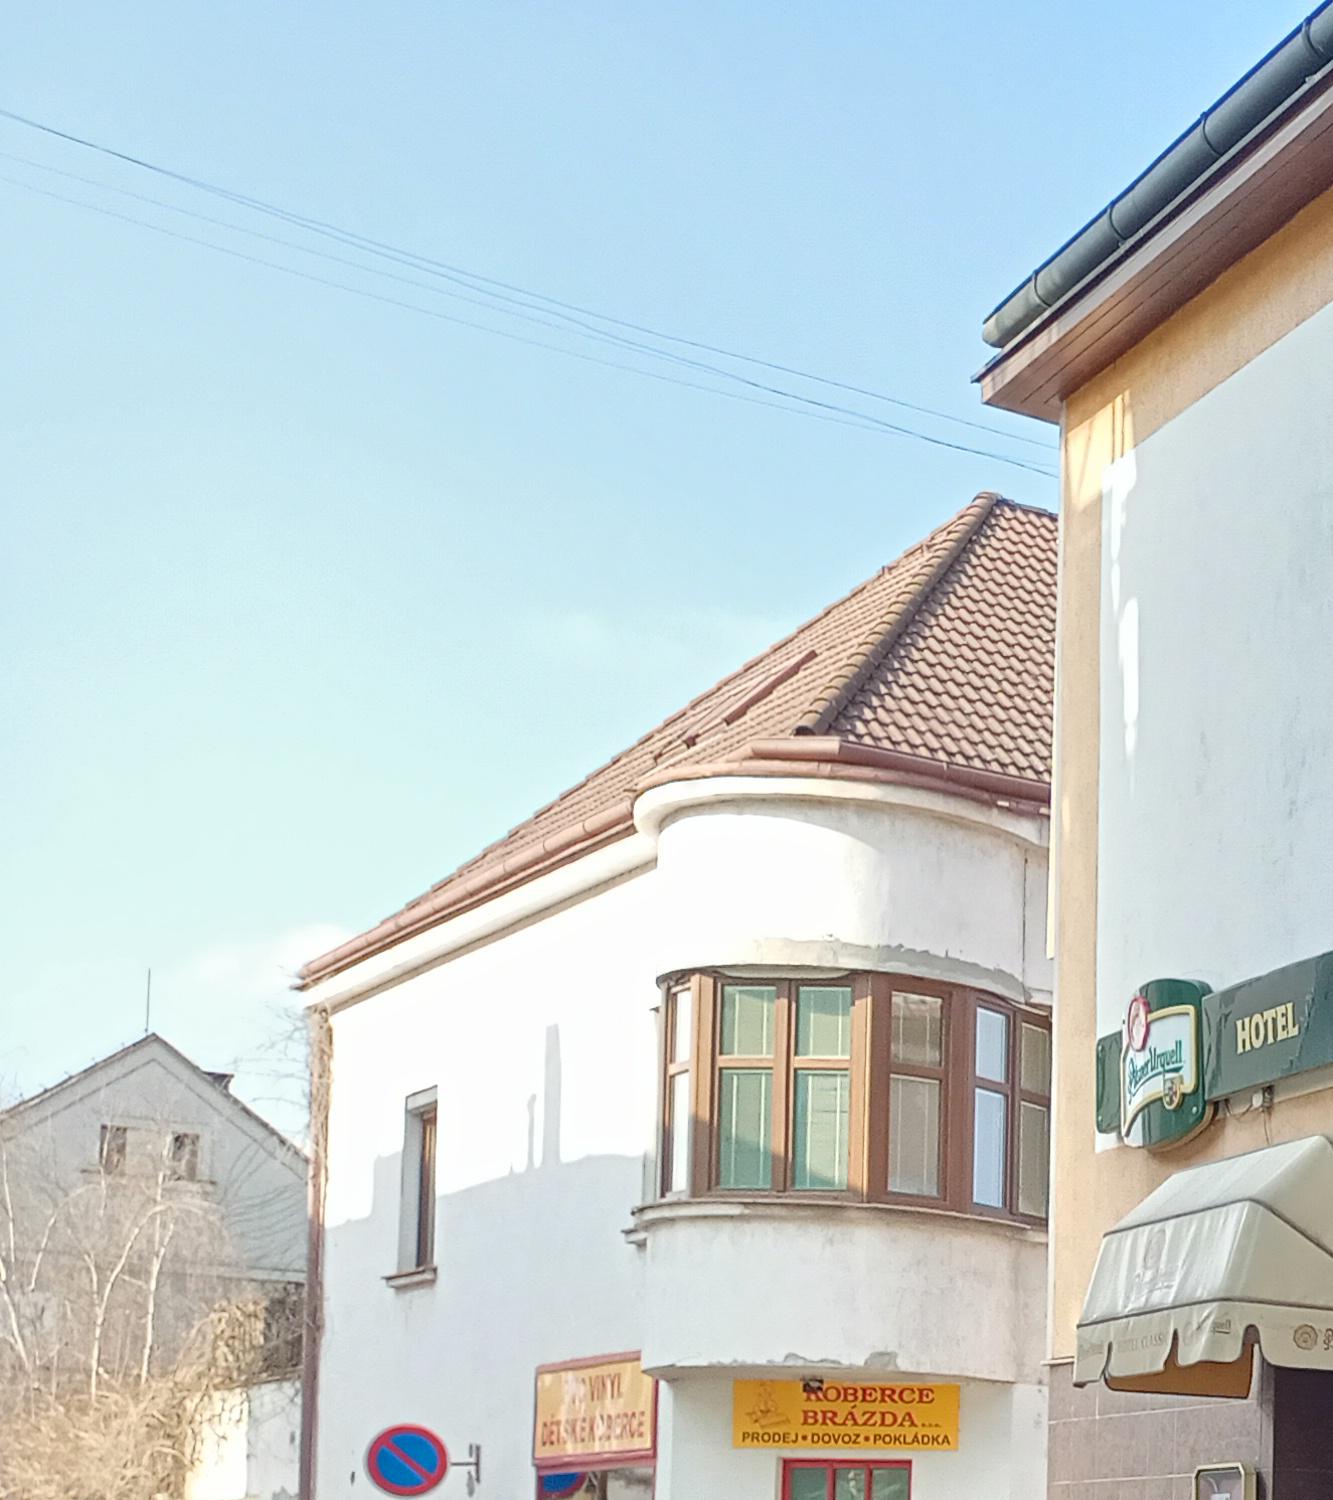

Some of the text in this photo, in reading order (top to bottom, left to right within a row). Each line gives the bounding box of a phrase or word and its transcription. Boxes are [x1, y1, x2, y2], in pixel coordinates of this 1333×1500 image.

[1235, 1002, 1300, 1055] HOTEL
[801, 1404, 919, 1428] BRÁZDA
[741, 1431, 951, 1446] PRODEJ DOVOZ POKLÁDKA
